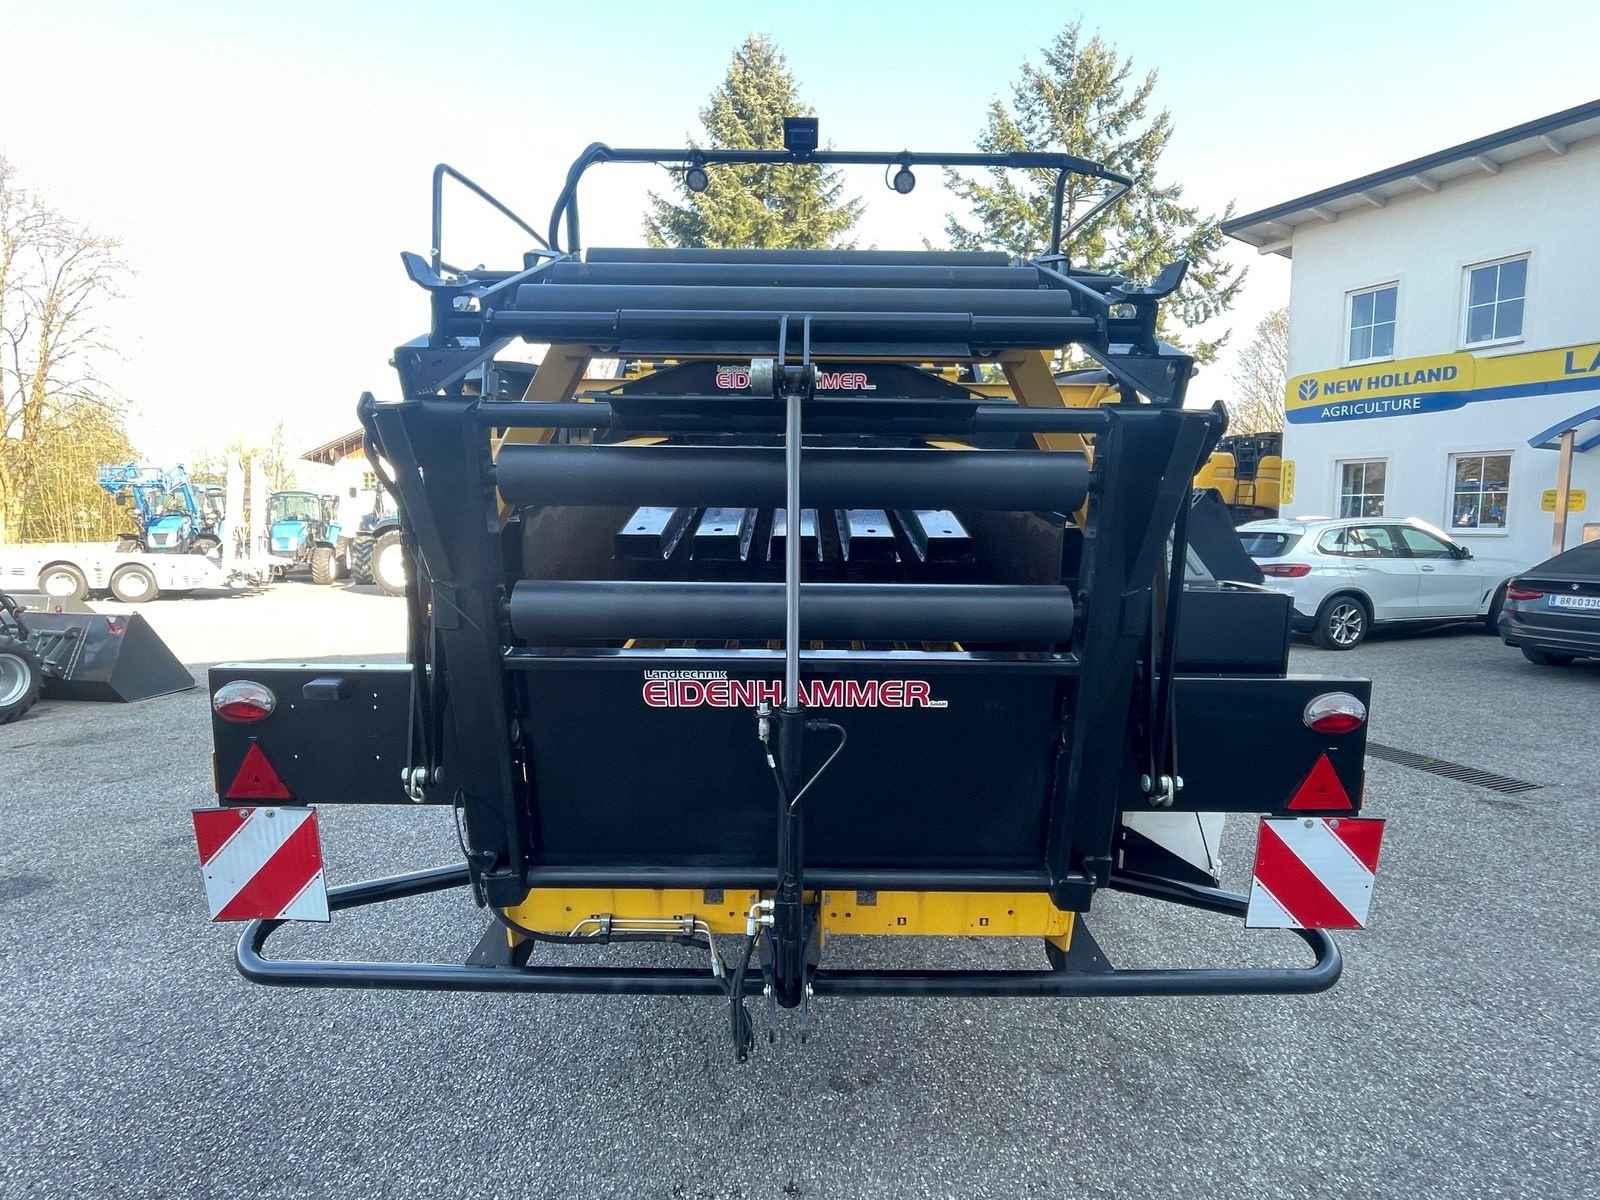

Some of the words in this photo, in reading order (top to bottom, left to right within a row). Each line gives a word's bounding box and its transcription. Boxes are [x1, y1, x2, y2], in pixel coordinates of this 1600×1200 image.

[1323, 378, 1363, 396] NEW
[1367, 365, 1457, 390] HOLLAND
[1321, 397, 1421, 418] AGRICULTURE
[643, 670, 728, 680] Landtechnik
